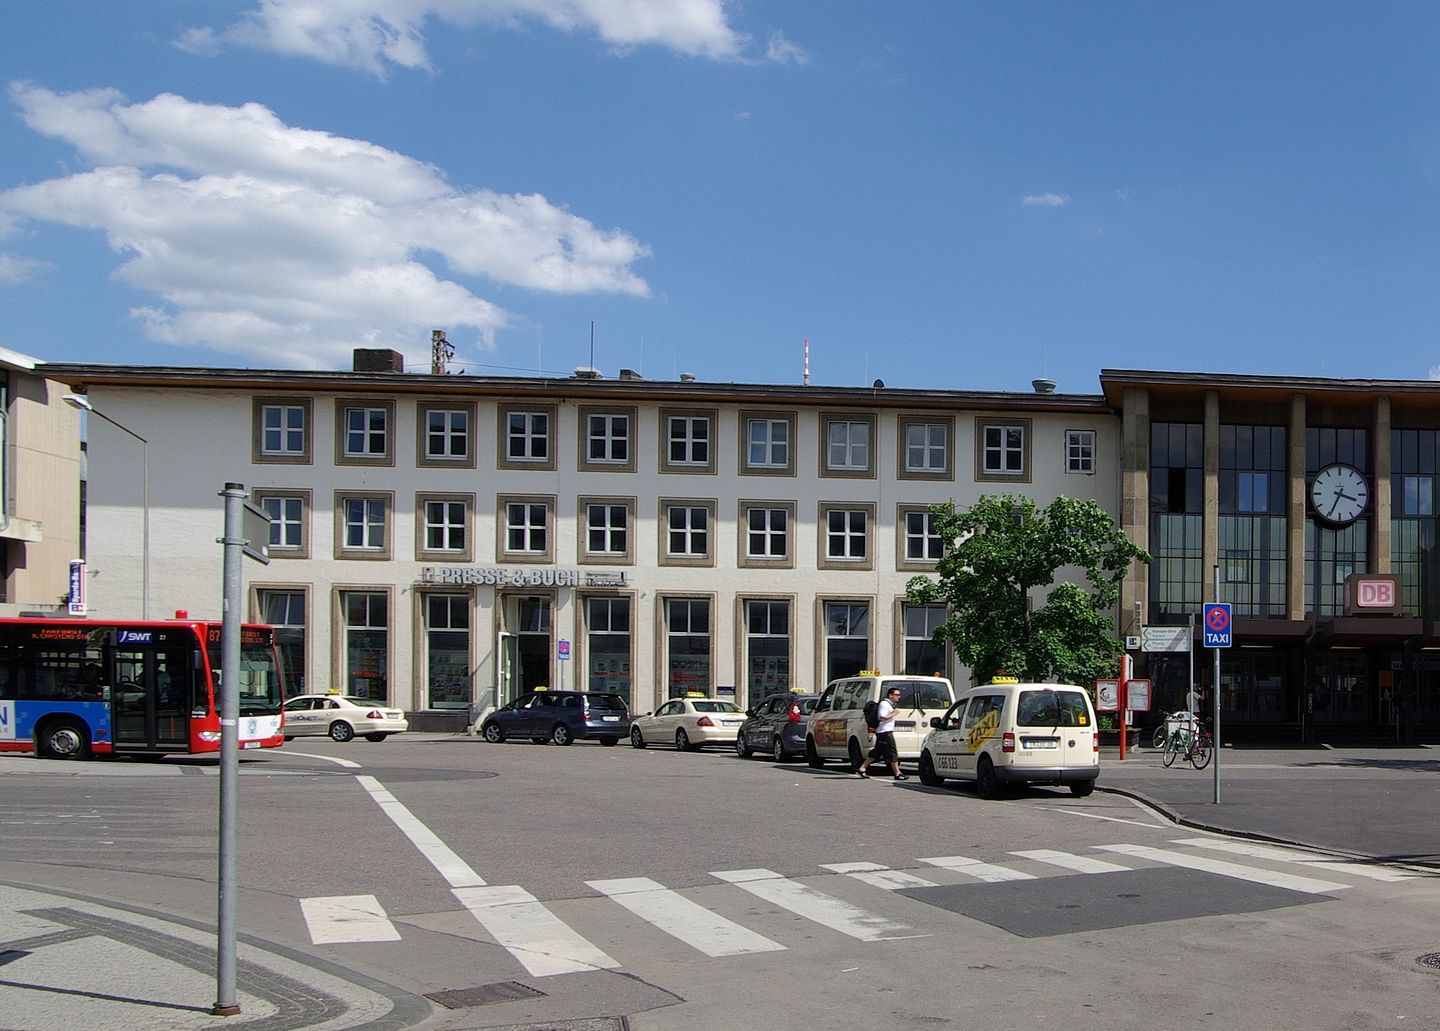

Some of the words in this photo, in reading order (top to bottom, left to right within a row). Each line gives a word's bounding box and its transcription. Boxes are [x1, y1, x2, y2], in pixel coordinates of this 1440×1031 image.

[440, 567, 507, 585] PRESSE
[511, 568, 526, 587] &
[530, 569, 579, 586] BUCH
[1362, 584, 1391, 603] DB
[128, 632, 152, 641] SWT
[208, 629, 221, 642] 87
[1206, 633, 1229, 644] TAXI
[968, 711, 996, 745] TAXI
